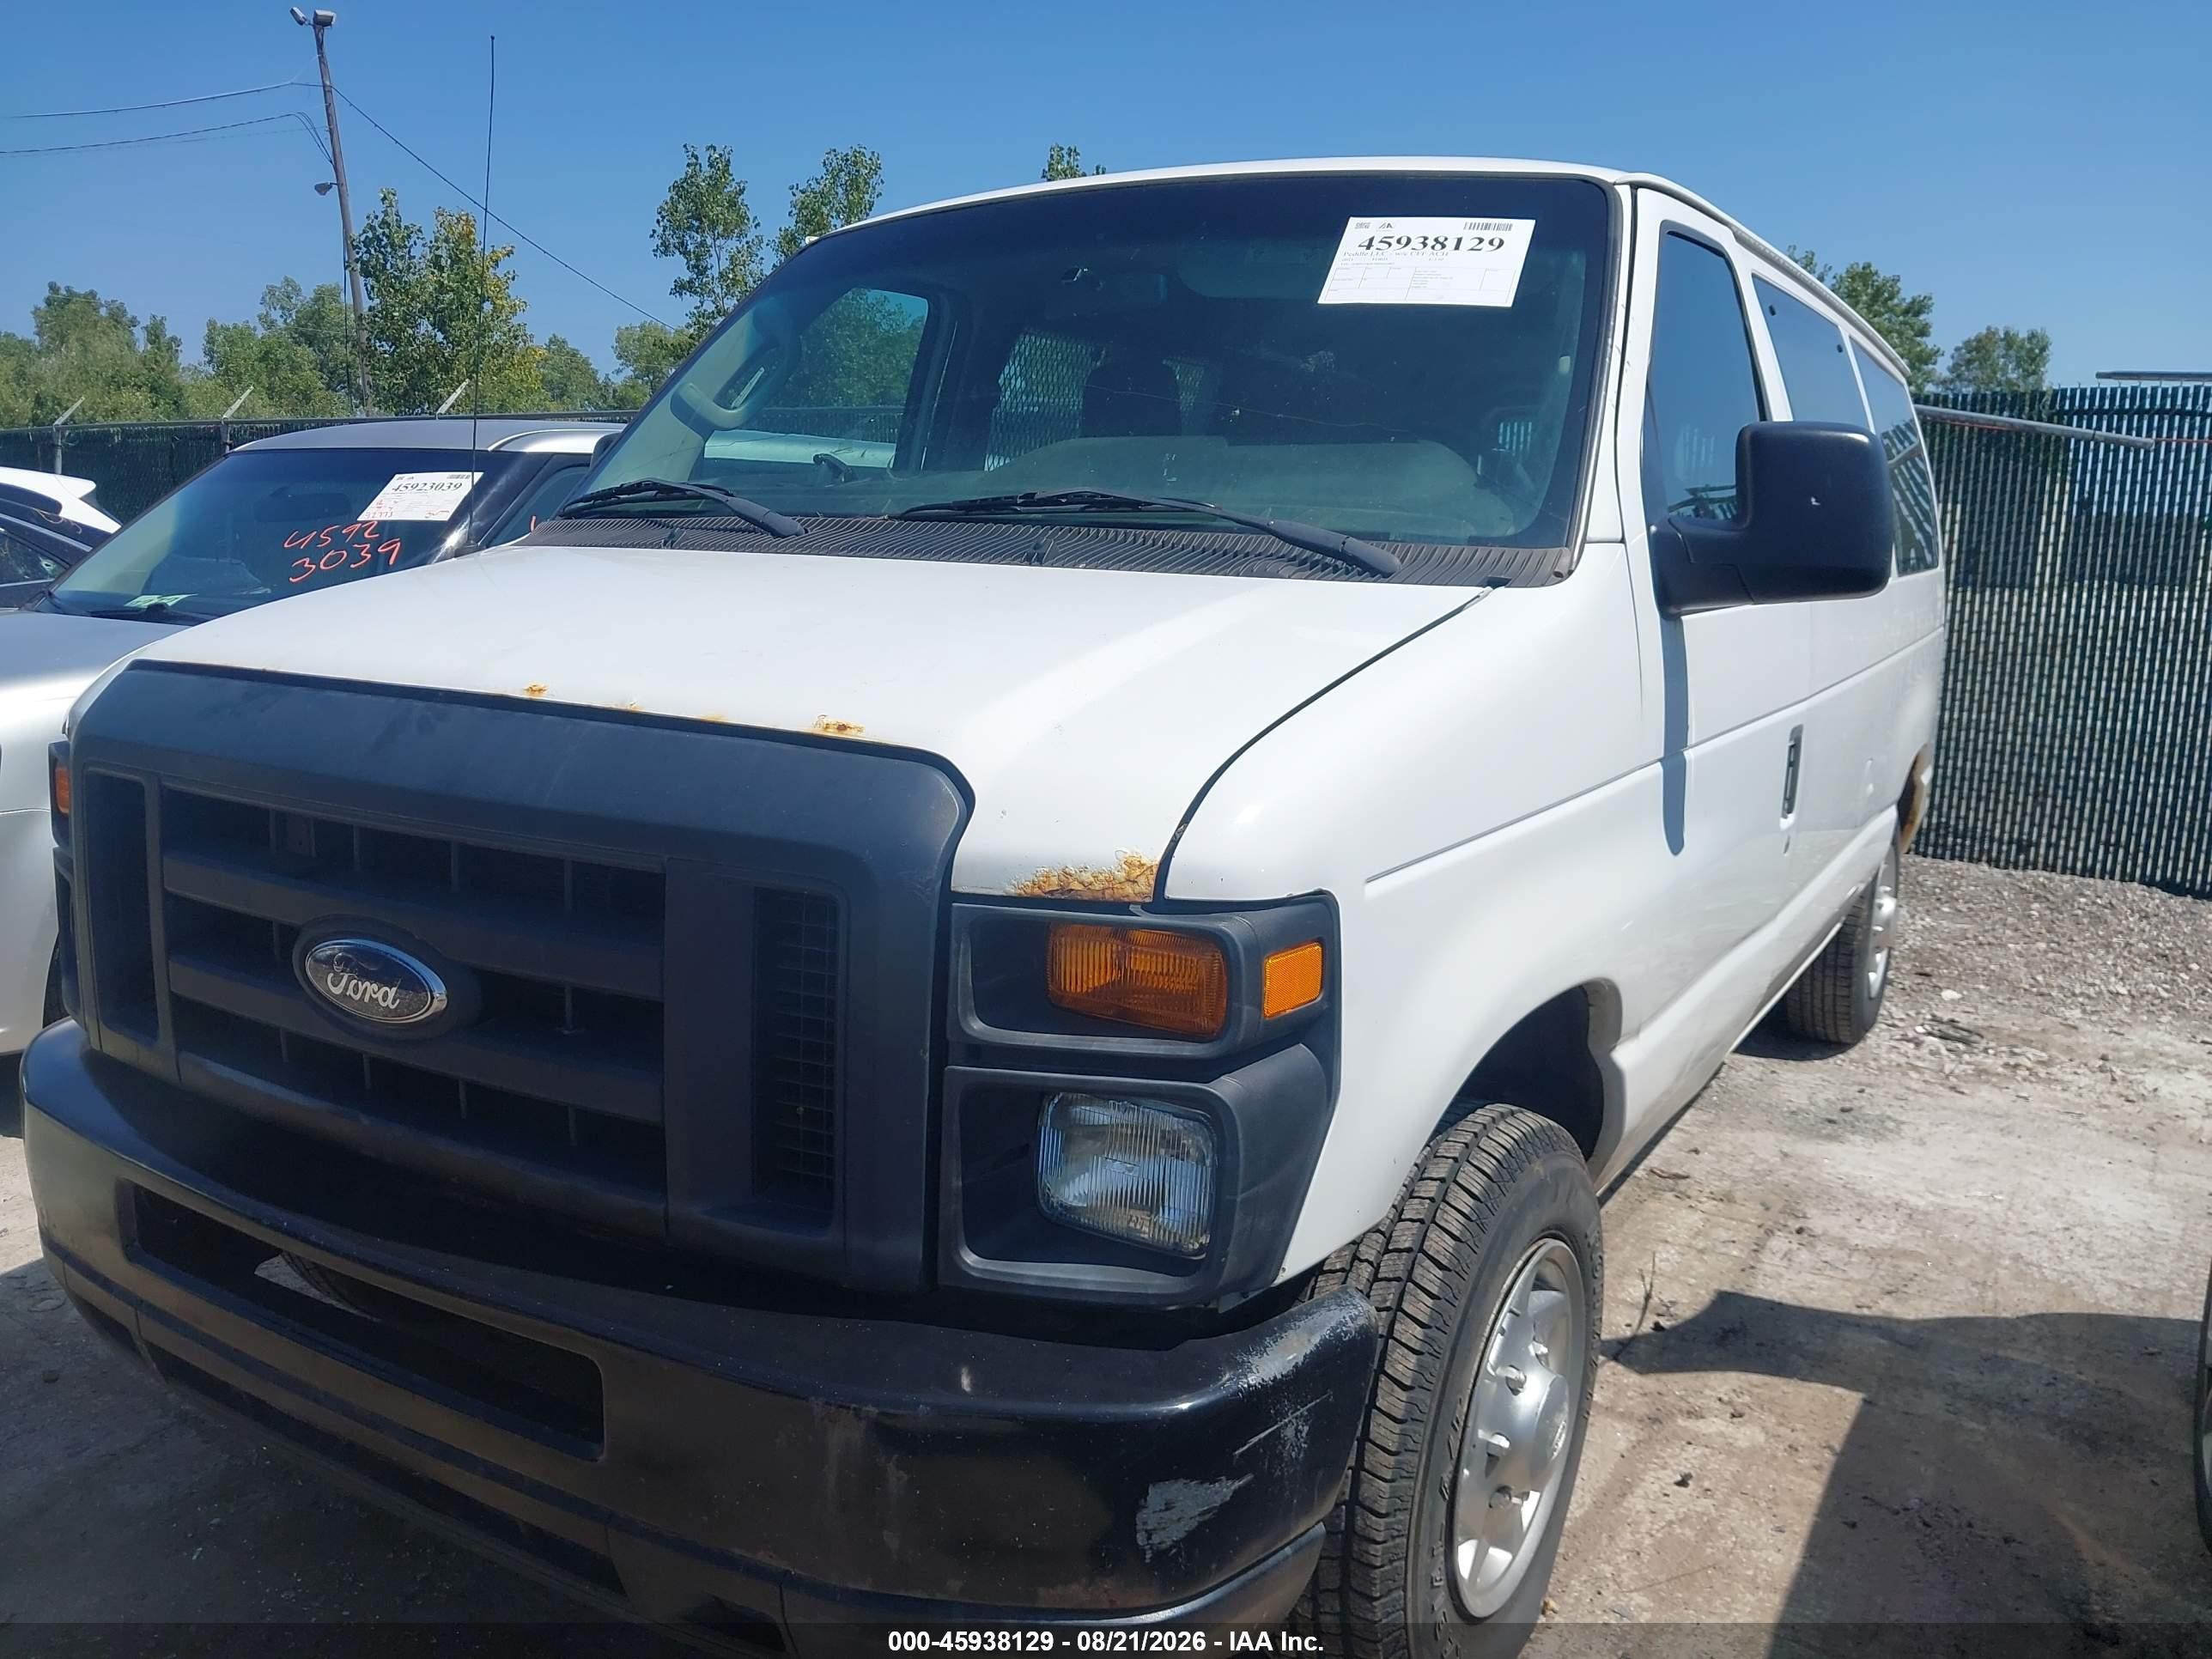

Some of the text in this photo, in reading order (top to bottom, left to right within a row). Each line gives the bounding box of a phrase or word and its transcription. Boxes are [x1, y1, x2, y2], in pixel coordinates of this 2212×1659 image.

[1358, 234, 1505, 252] 45938129
[392, 482, 463, 492] 45923039
[283, 520, 380, 549] 4592
[289, 538, 402, 583] 3039
[327, 952, 401, 1010] Ford
